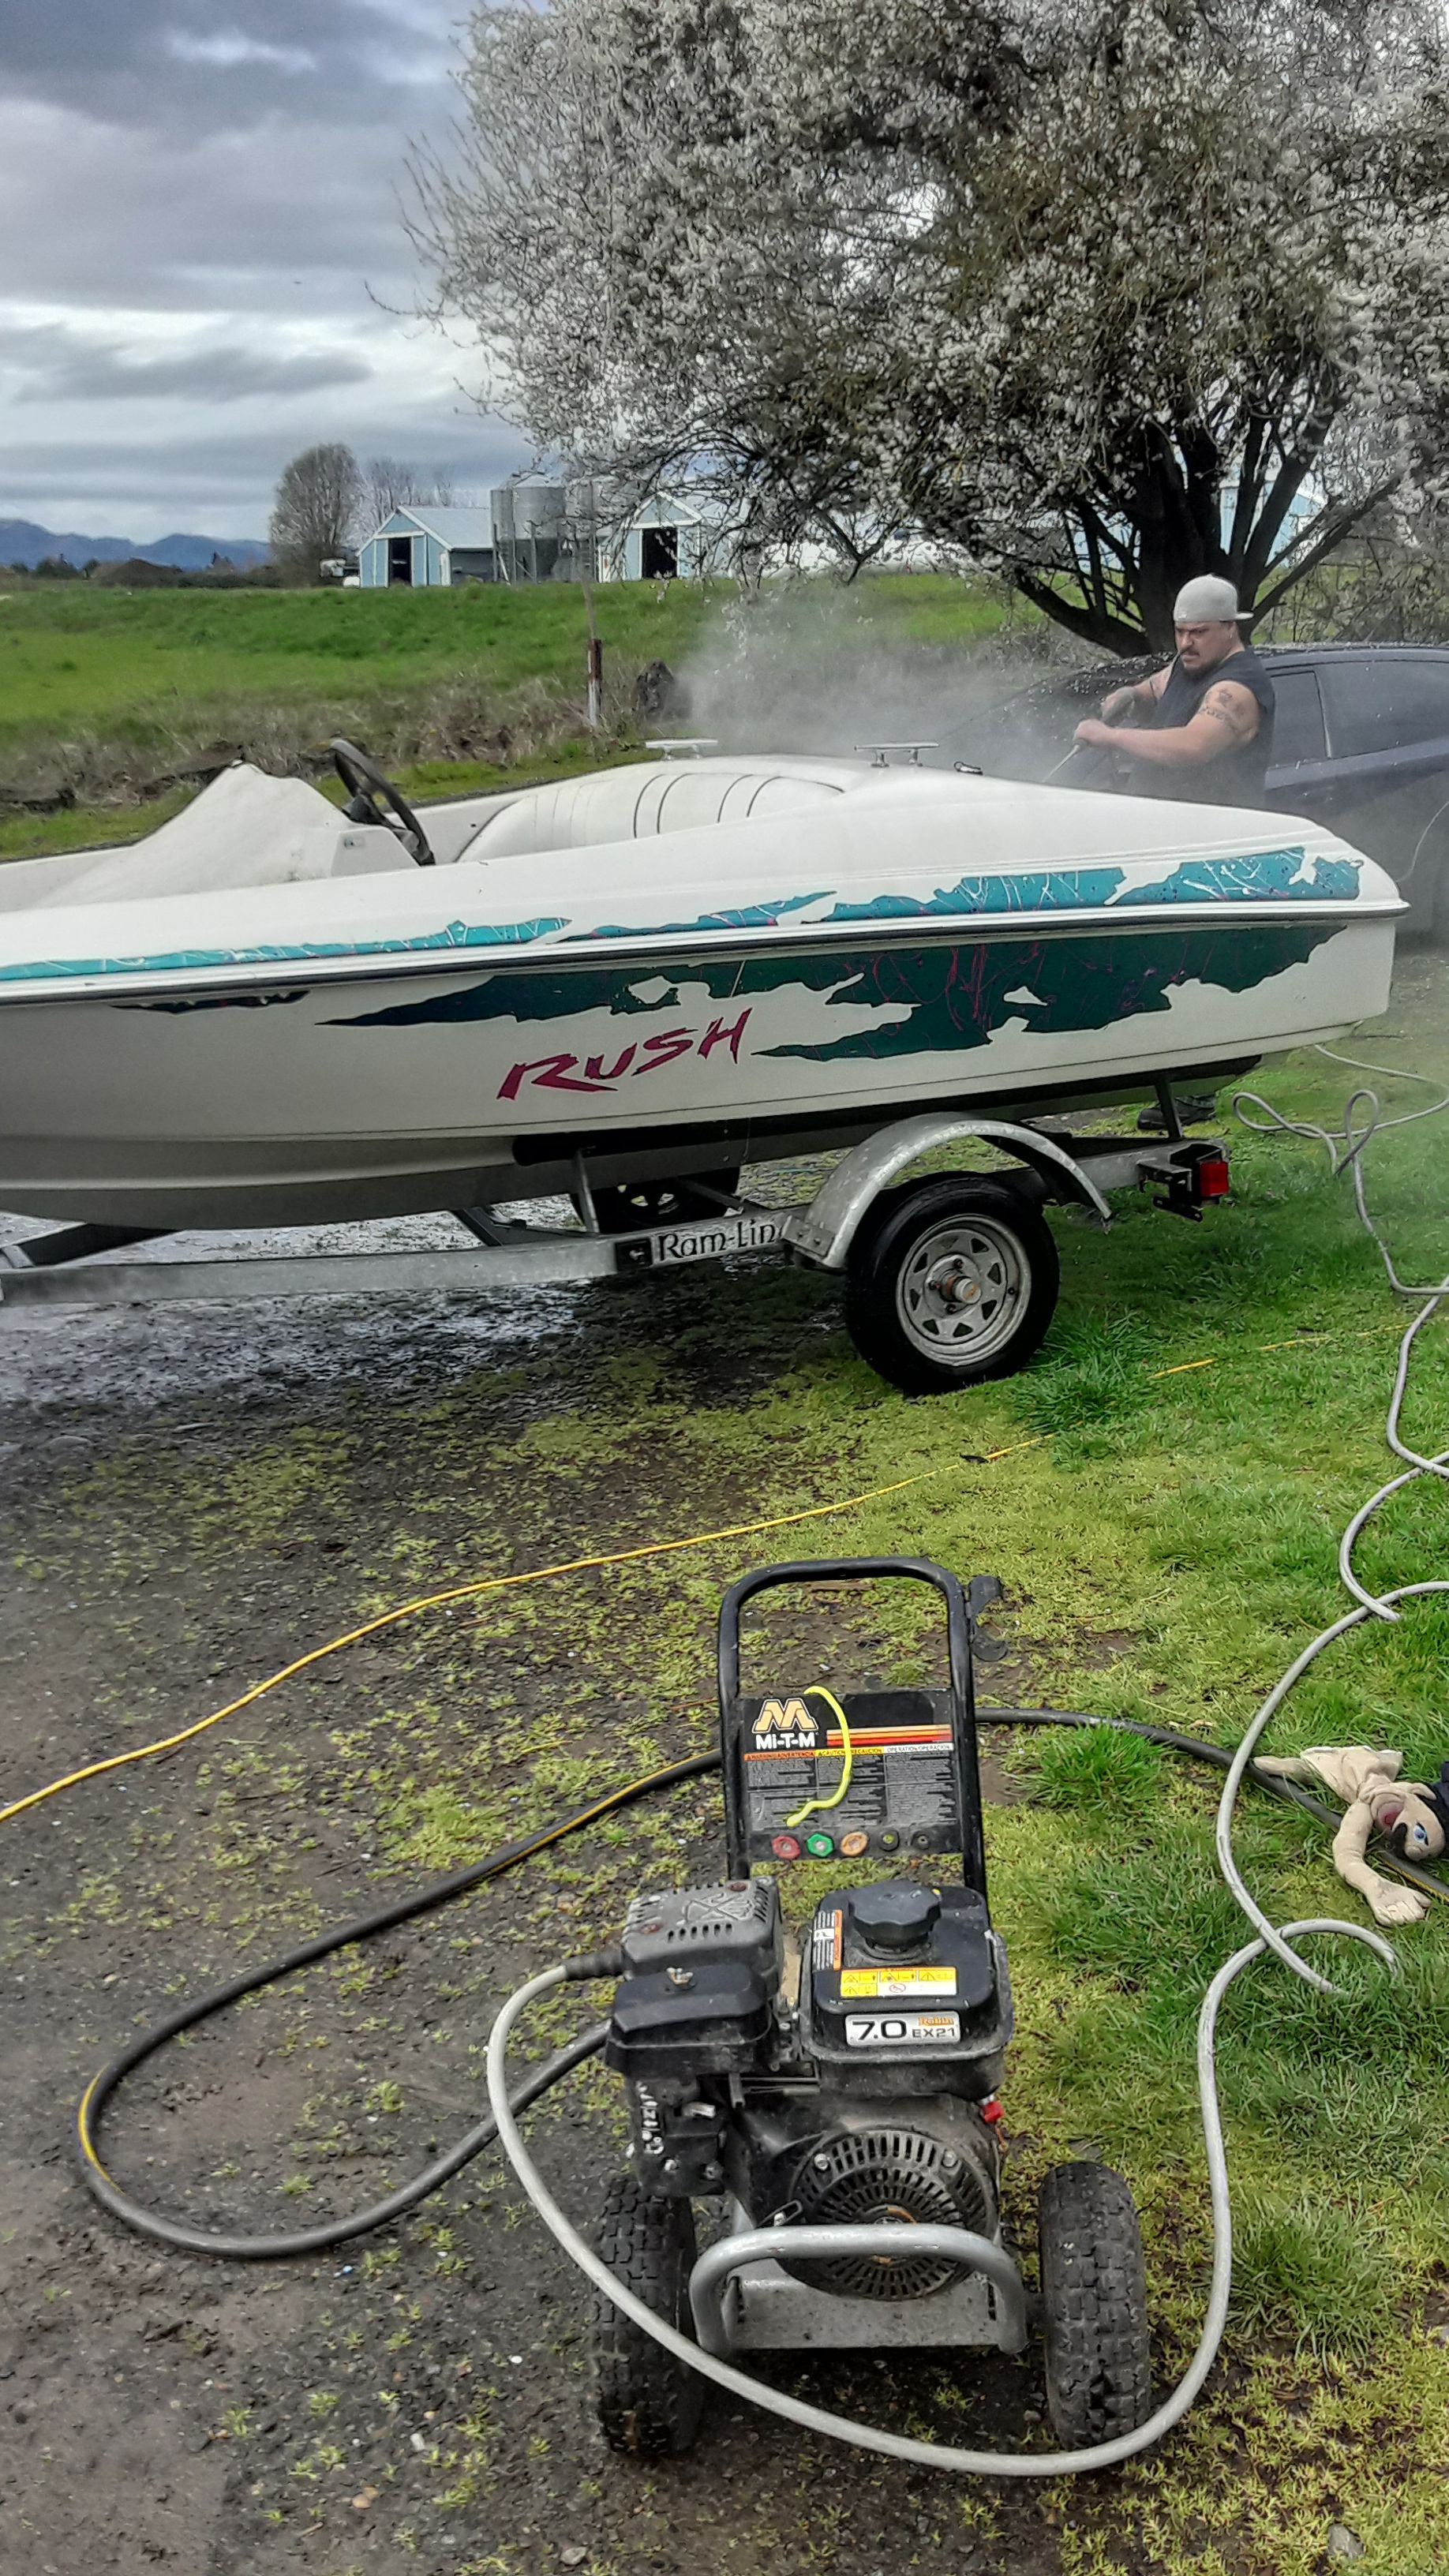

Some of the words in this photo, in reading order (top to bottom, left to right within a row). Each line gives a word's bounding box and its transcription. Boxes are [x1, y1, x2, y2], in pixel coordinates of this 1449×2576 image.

[496, 1007, 753, 1100] RUSH
[657, 1219, 784, 1261] Ram-Lin
[852, 2019, 907, 2041] 7.0
[912, 2027, 955, 2038] EX21
